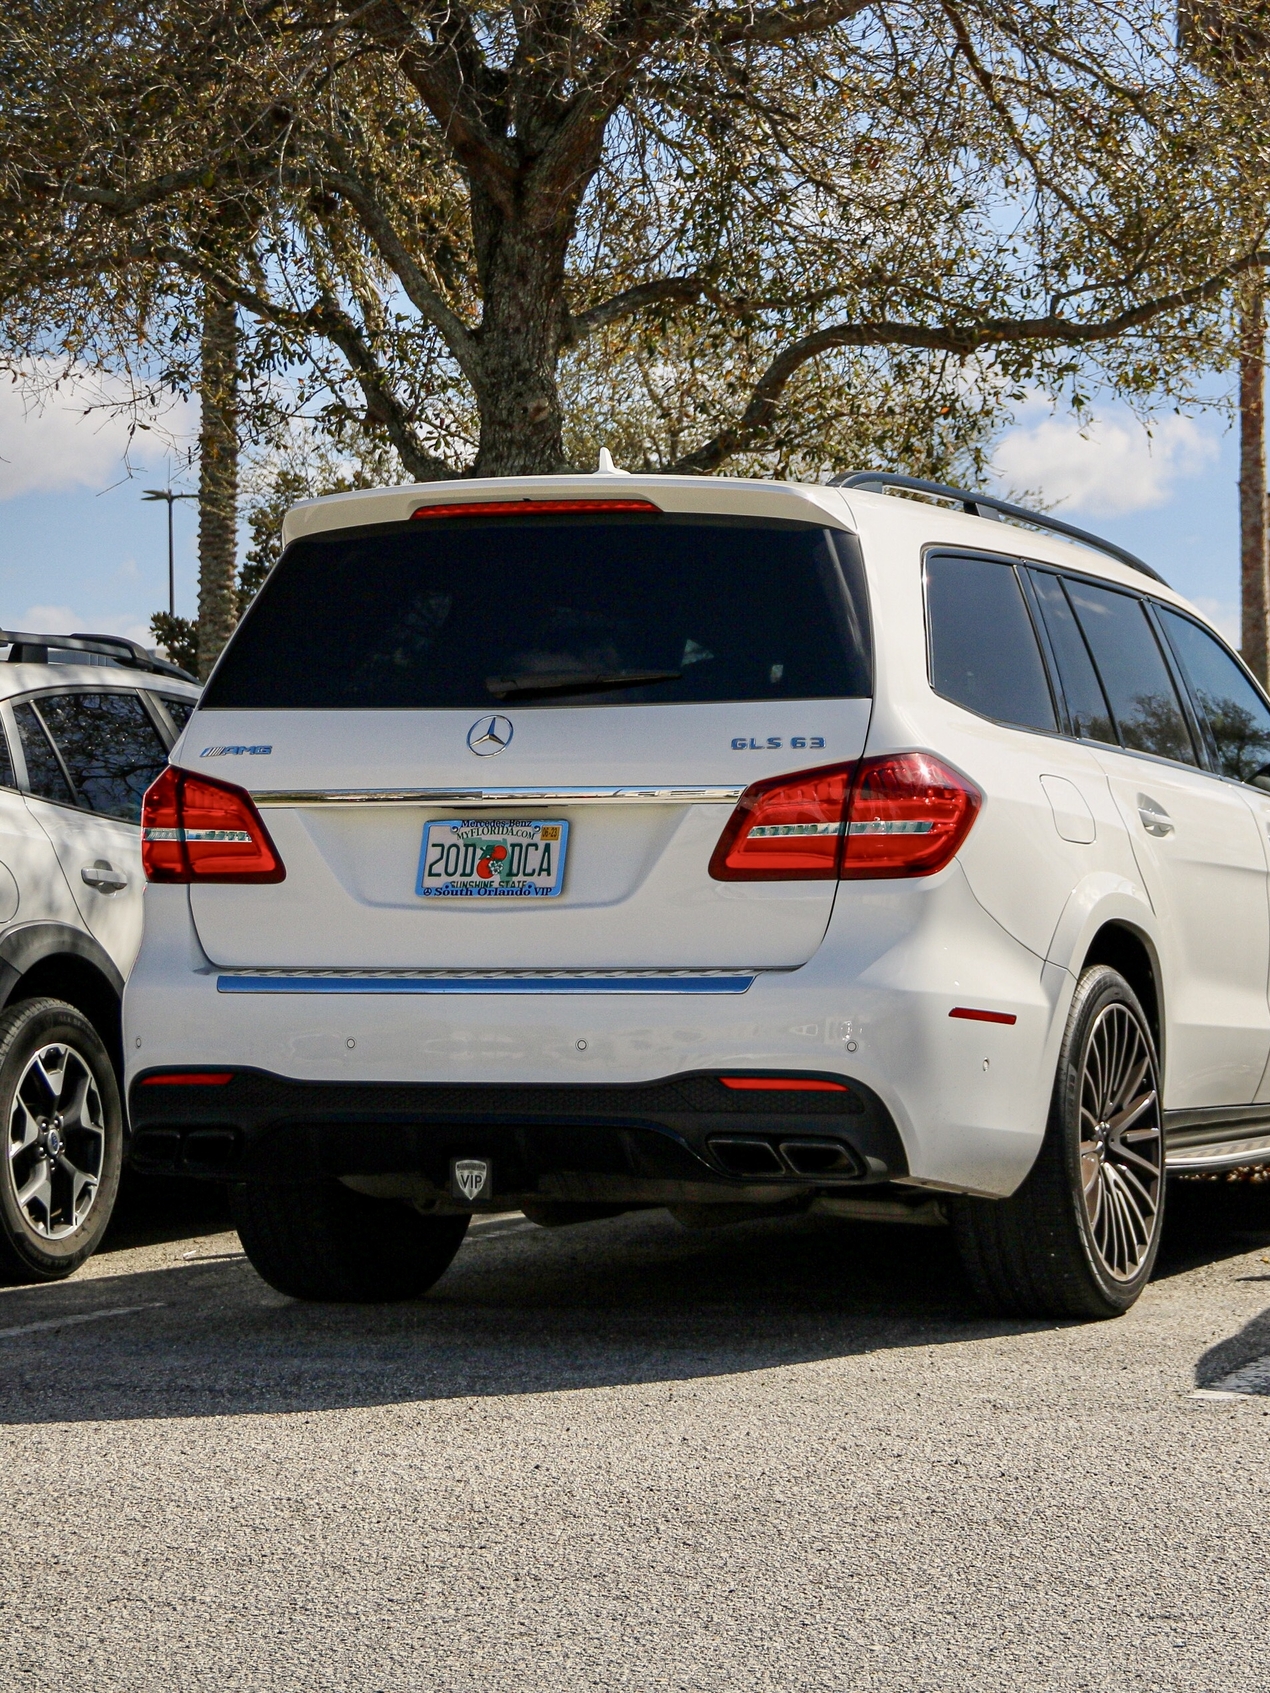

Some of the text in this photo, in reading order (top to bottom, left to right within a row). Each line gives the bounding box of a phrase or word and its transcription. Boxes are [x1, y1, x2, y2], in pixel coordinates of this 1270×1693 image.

[731, 737, 825, 750] GLS 63
[222, 745, 272, 755] AMG
[461, 820, 532, 828] Mercedes-Benz
[457, 826, 535, 840] MYFLORIDA.COM
[428, 842, 551, 877] 20D DCA
[450, 880, 527, 888] SUNSHINE STATE
[434, 887, 552, 896] South Orlando VIP
[460, 1174, 483, 1189] VIP
